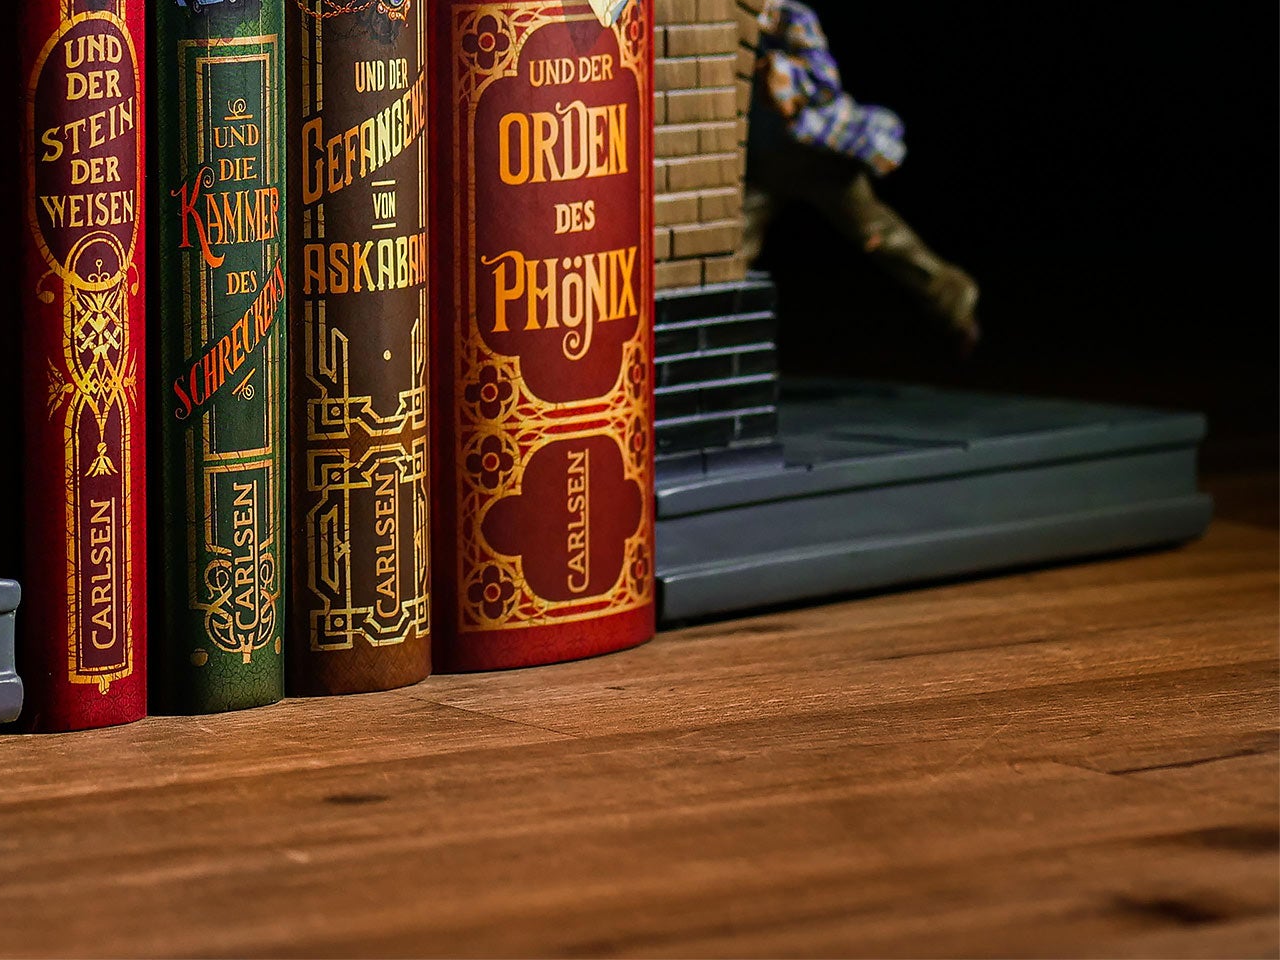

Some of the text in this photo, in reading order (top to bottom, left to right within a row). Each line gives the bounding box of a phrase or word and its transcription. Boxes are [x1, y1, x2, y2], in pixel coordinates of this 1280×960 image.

[64, 34, 123, 68] UND
[354, 57, 409, 94] UND DER
[529, 54, 613, 88] UND DER
[65, 69, 123, 101] DER
[41, 96, 134, 162] STEIN
[213, 123, 259, 149] UND
[301, 70, 426, 206] GEFANGENE
[498, 99, 629, 186] ORDEN
[70, 156, 122, 186] DER
[218, 156, 258, 182] DIE
[39, 190, 135, 229] WEISEN
[171, 166, 280, 268] KAMMER
[372, 190, 396, 220] VON
[554, 200, 596, 235] DES
[226, 270, 258, 296] DES
[302, 232, 426, 296] ASKABAN
[481, 245, 638, 361] PHÖNIX
[173, 257, 285, 421] SCHRECKENS
[375, 470, 401, 618] CARLSEN
[567, 448, 590, 594] CARLSEN
[90, 496, 116, 650] CARLSEN
[232, 479, 258, 632] CARLSEN
